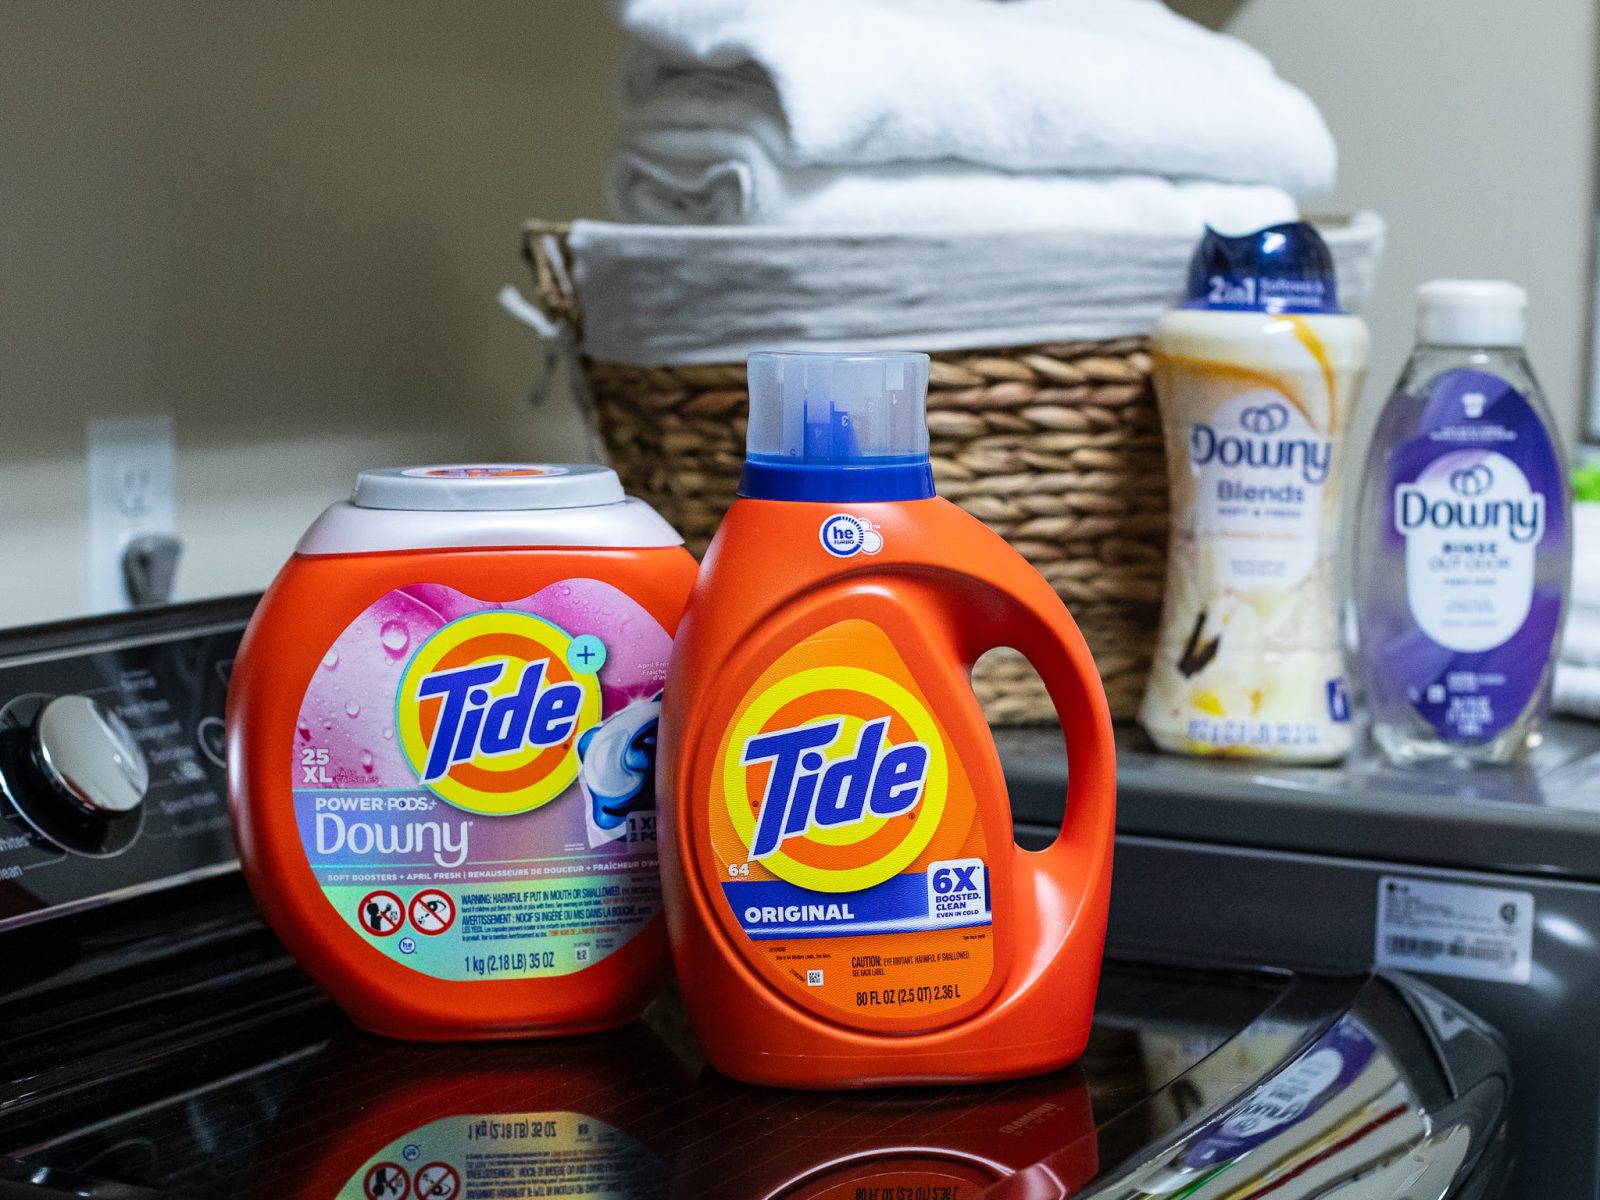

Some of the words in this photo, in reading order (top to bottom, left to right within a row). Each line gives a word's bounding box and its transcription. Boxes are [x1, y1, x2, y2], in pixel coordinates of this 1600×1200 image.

[1190, 423, 1332, 485] Downy
[1402, 491, 1538, 543] Downy
[833, 526, 854, 539] he
[414, 657, 585, 785] Tide
[302, 748, 330, 766] 25
[302, 767, 333, 783] XL
[739, 715, 931, 861] Tide
[316, 813, 470, 868] Downy
[327, 874, 349, 882] SOFT
[352, 873, 398, 881] BOOSTERS
[433, 872, 461, 880] FRESH
[468, 868, 529, 878] REHAUSSEURS
[531, 868, 542, 876] DE
[544, 865, 584, 874] DOUCEUR
[728, 863, 749, 877] 64
[530, 891, 542, 901] PUT
[543, 890, 549, 901] IN
[550, 889, 572, 900] MOUTH
[744, 904, 854, 923] ORIGINAL
[936, 902, 967, 911] CLEAN
[465, 956, 470, 972] 1
[473, 956, 485, 975] kg
[487, 954, 510, 975] (2.18
[511, 953, 527, 973] LB)
[529, 952, 540, 969] 35
[542, 952, 555, 968] OZ
[851, 955, 882, 968] CAUTION:
[883, 957, 893, 967] EYE
[860, 969, 871, 977] BACK
[856, 991, 868, 1006] 80
[870, 990, 881, 1005] FL
[883, 990, 896, 1004] OZ
[897, 988, 915, 1006] (2.5
[917, 986, 932, 1004] QT)
[934, 985, 953, 1000] 2.36
[955, 984, 961, 998] L
